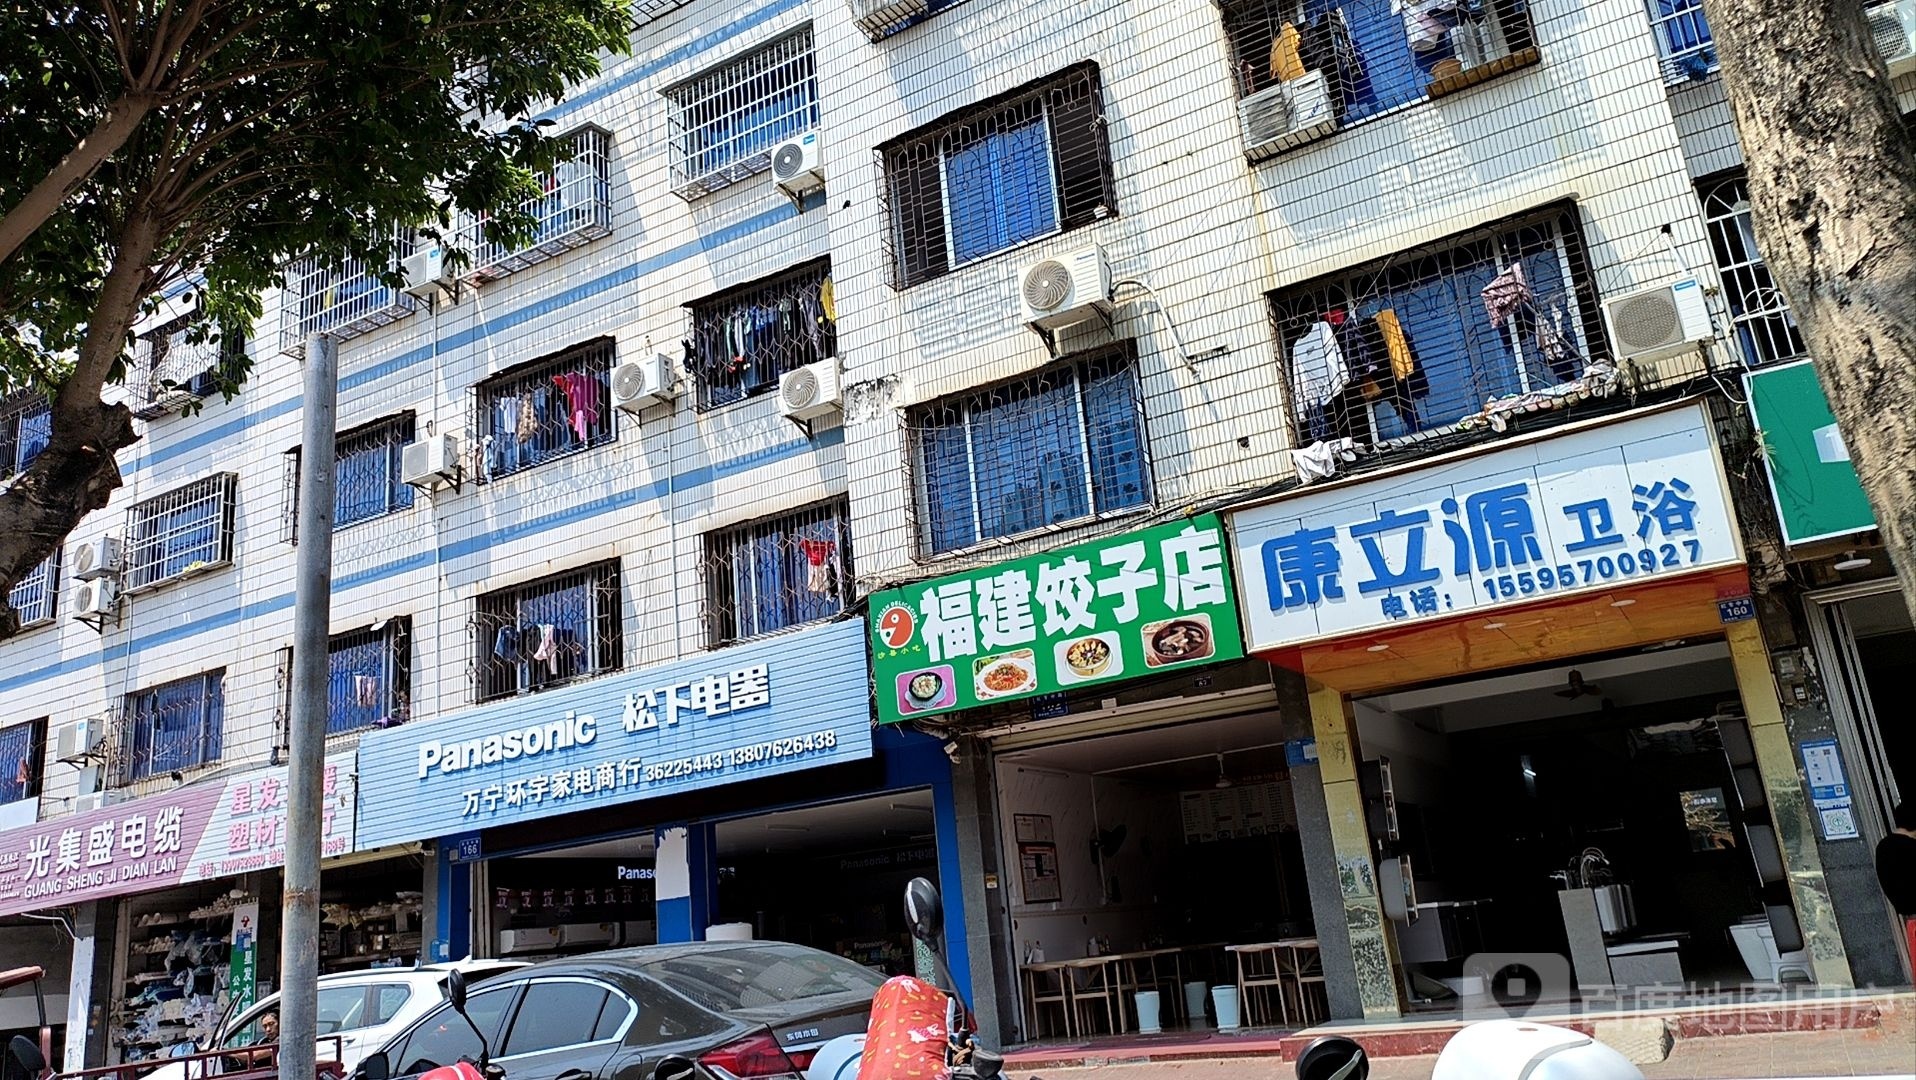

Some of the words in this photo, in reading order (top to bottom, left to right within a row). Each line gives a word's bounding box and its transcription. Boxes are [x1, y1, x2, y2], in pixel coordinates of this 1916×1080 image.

[1261, 482, 1541, 611] 康立源
[1563, 477, 1697, 552] 卫浴
[1482, 538, 1701, 600] 15595700927
[919, 525, 1227, 663] 福建饺子店
[1726, 605, 1748, 617] 160
[418, 710, 597, 779] Panasonic
[622, 662, 770, 734] 松下电器
[462, 757, 642, 817] 万宁环宇家电商行
[645, 752, 724, 783] 36225443
[728, 730, 837, 766] 13807626438
[24, 806, 184, 881] 光集盛电缆
[24, 880, 63, 898] GUANG
[66, 869, 104, 890] SHENG
[107, 868, 118, 884] JI
[122, 863, 150, 881] DIAN
[153, 857, 178, 874] LAN
[463, 844, 478, 855] 166
[786, 1028, 819, 1041] 东风本田
